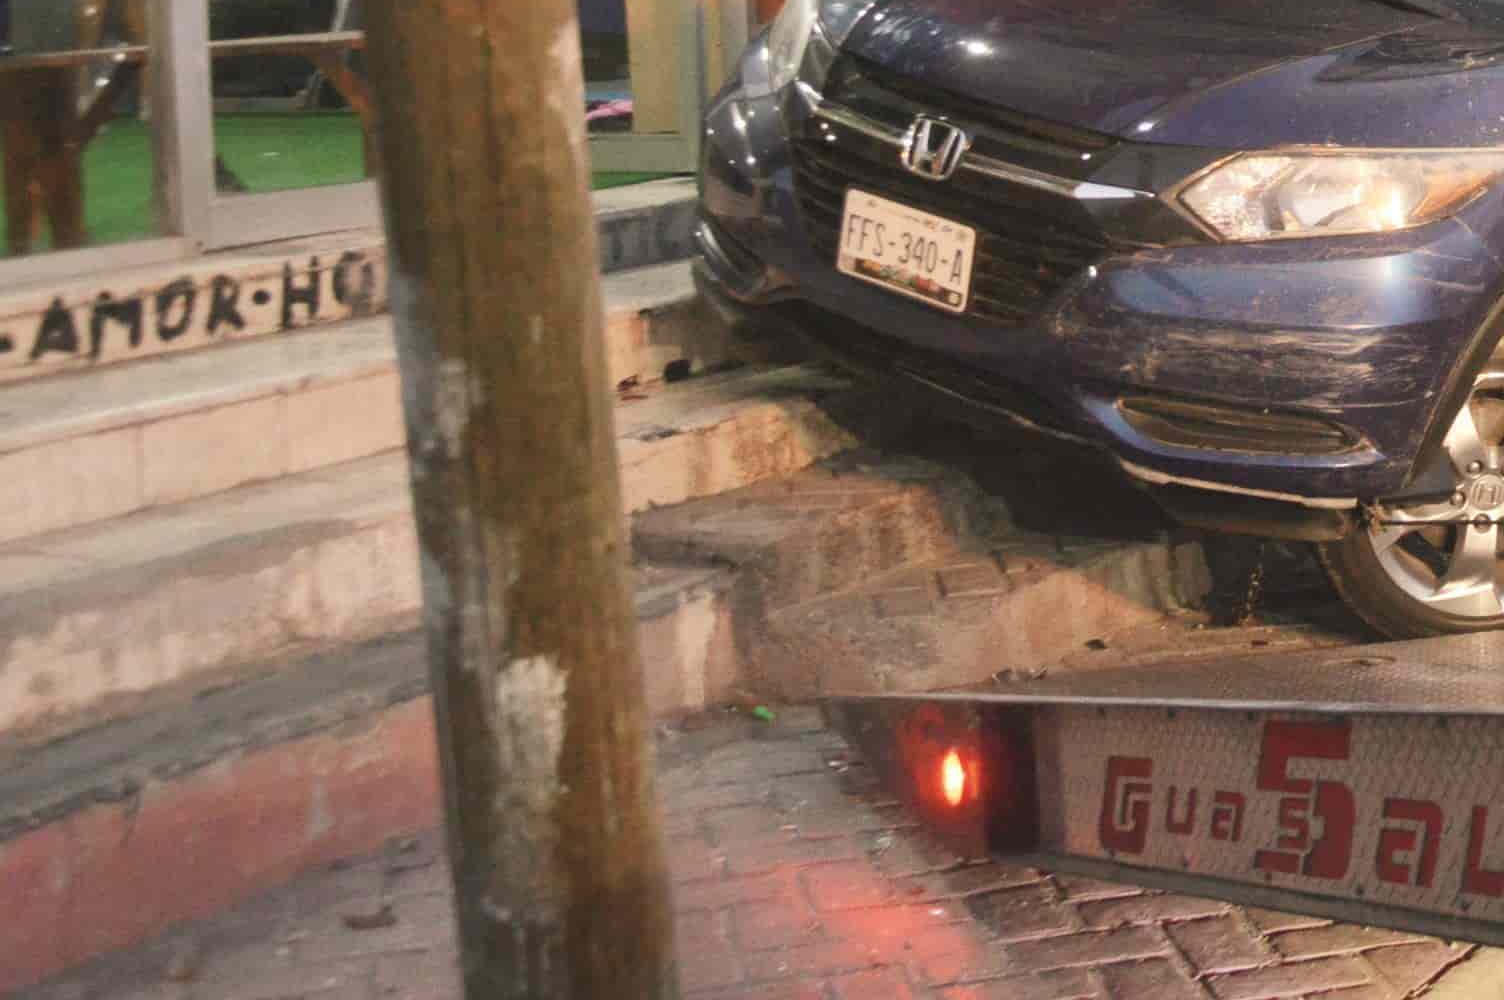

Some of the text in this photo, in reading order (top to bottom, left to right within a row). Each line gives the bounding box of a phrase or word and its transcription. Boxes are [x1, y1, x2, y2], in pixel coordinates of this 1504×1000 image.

[846, 212, 964, 287] FFS-340-A
[29, 249, 378, 362] AMOR HO
